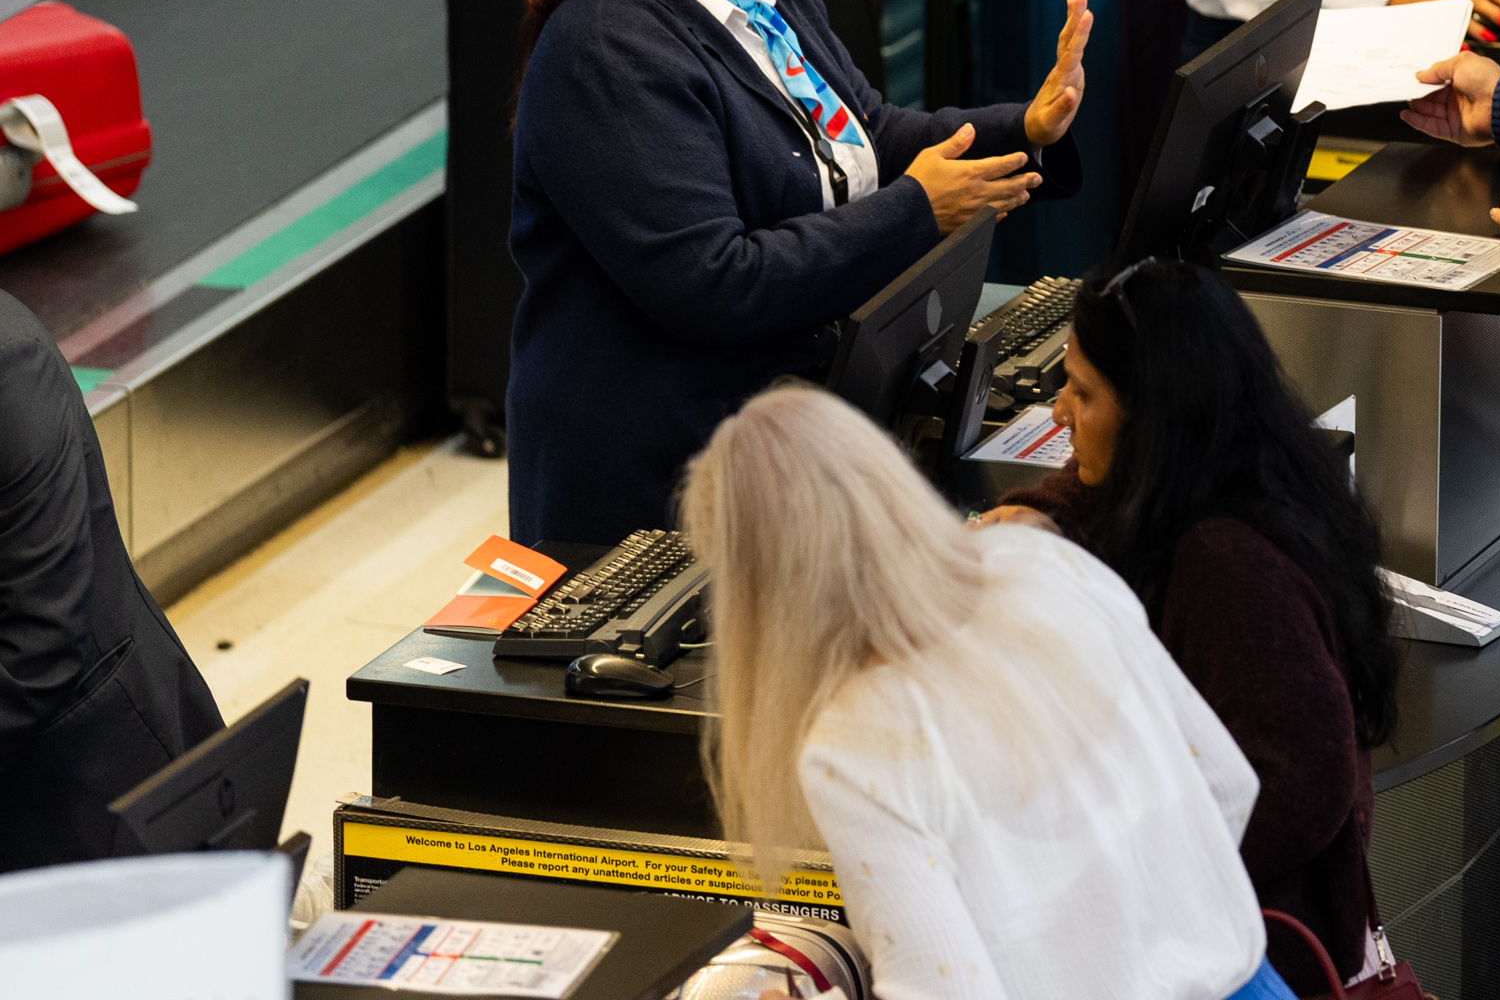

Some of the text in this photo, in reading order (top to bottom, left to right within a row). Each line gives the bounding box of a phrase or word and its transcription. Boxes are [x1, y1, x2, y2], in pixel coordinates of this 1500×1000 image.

[406, 835, 452, 849] Welcome
[455, 841, 465, 851] to
[468, 842, 487, 852] Los
[490, 844, 530, 856] Angeles
[534, 849, 598, 863] International
[601, 856, 639, 868] Airport.
[645, 860, 662, 870] For
[665, 863, 688, 873] your
[691, 865, 723, 877] Safety
[795, 876, 829, 887] please
[501, 857, 535, 869] Please
[538, 863, 569, 873] report
[572, 866, 590, 876] any
[593, 868, 651, 881] unattended
[654, 874, 691, 885] articles
[694, 878, 705, 887] or
[708, 881, 763, 892] suspicious
[813, 889, 824, 899] to
